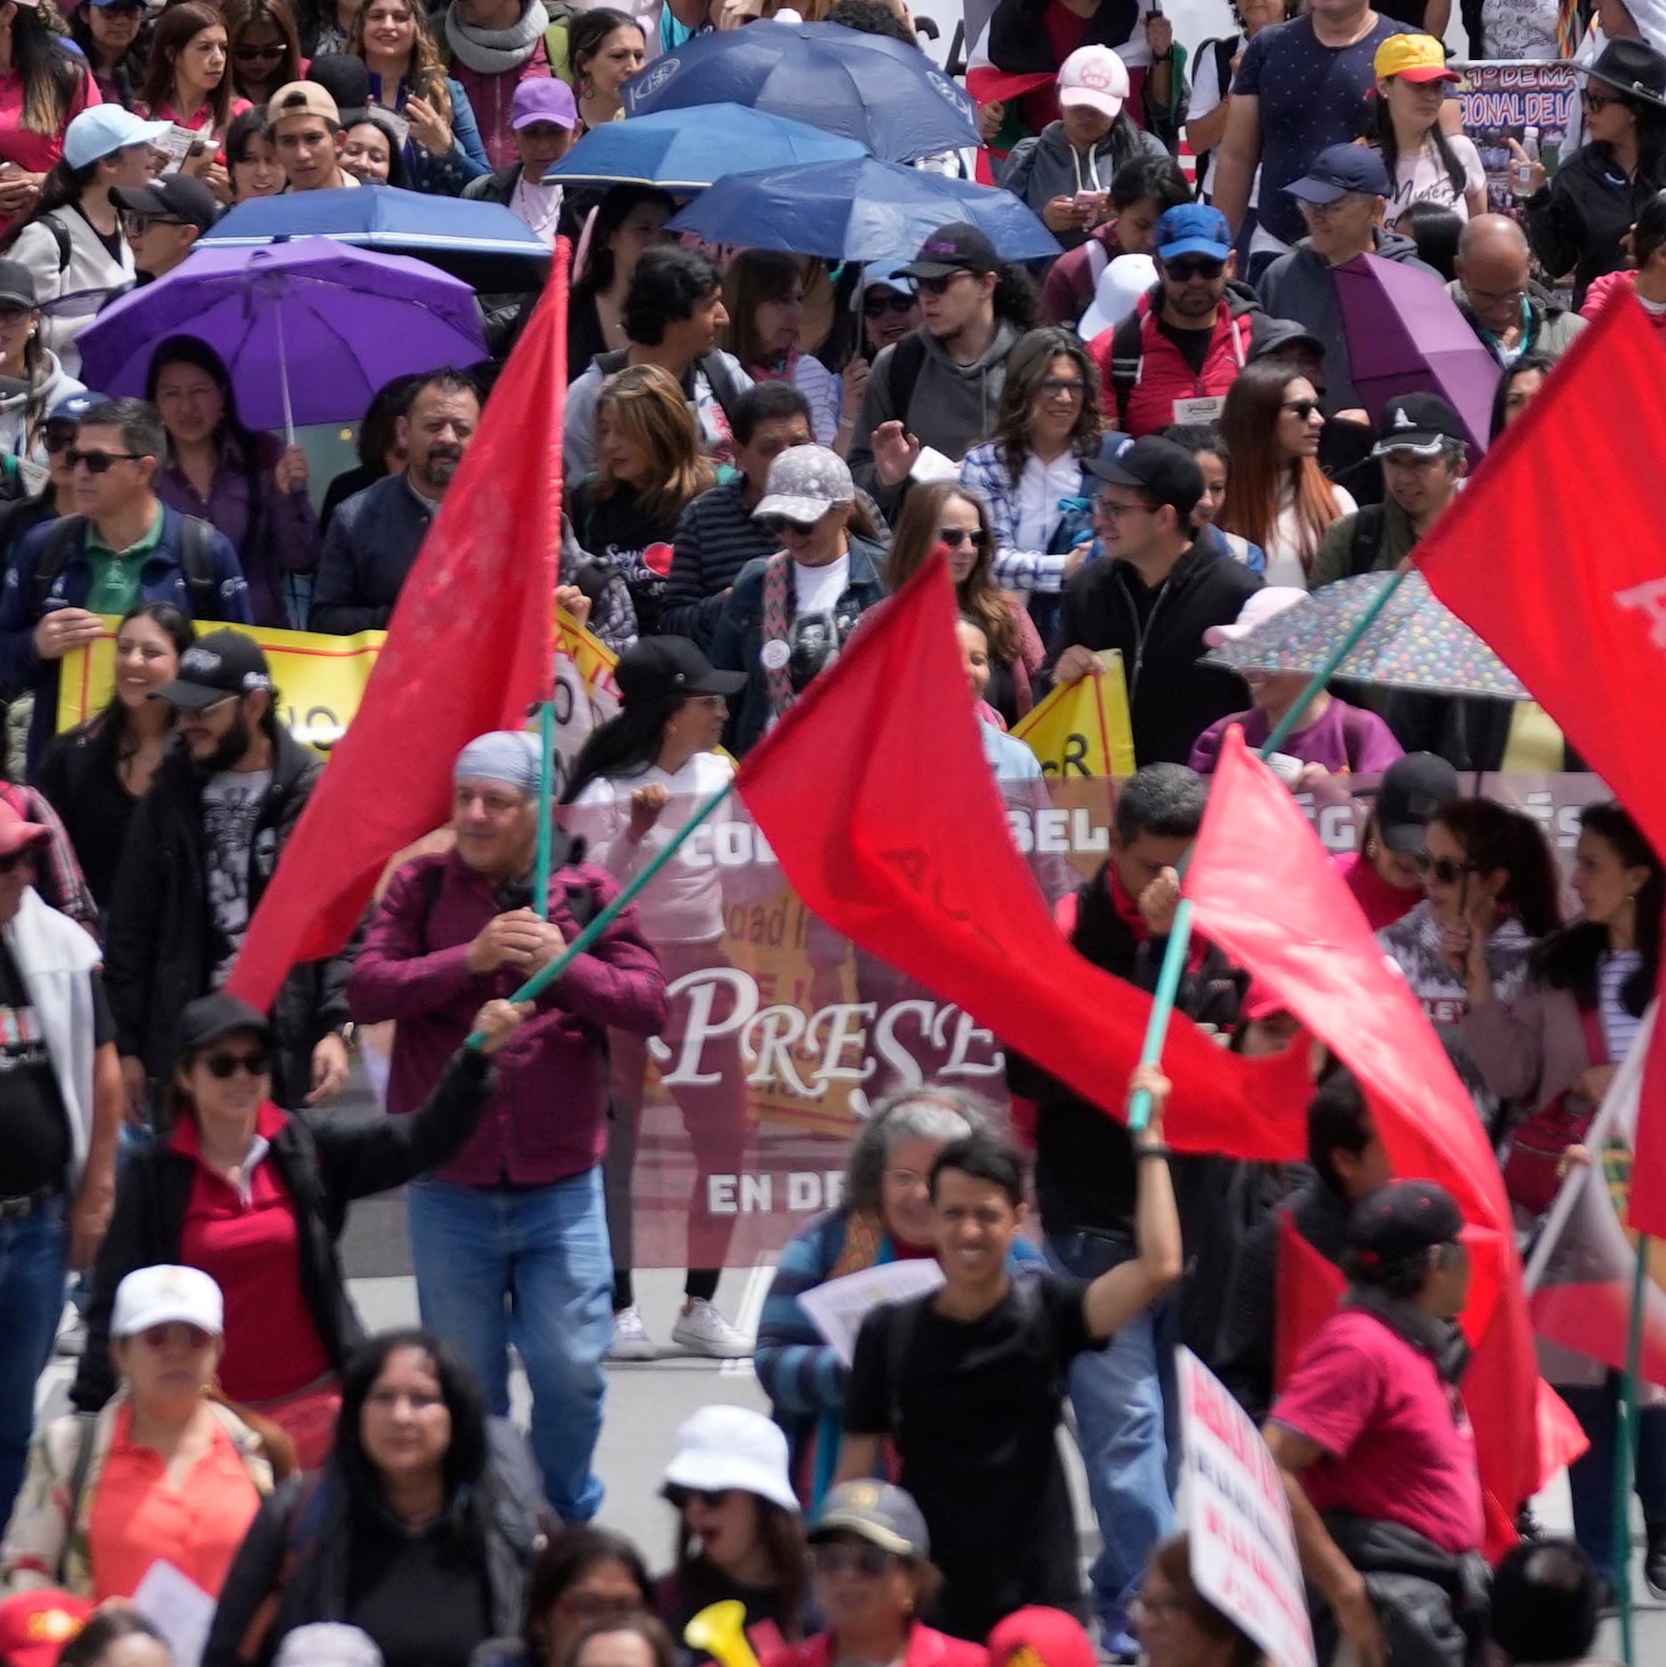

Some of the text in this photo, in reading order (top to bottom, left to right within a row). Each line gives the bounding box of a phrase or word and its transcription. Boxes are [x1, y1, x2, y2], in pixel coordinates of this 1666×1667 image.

[1498, 66, 1535, 89] DE
[1537, 66, 1578, 89] MA
[1457, 91, 1527, 127] CIONAL
[1526, 91, 1555, 127] DE
